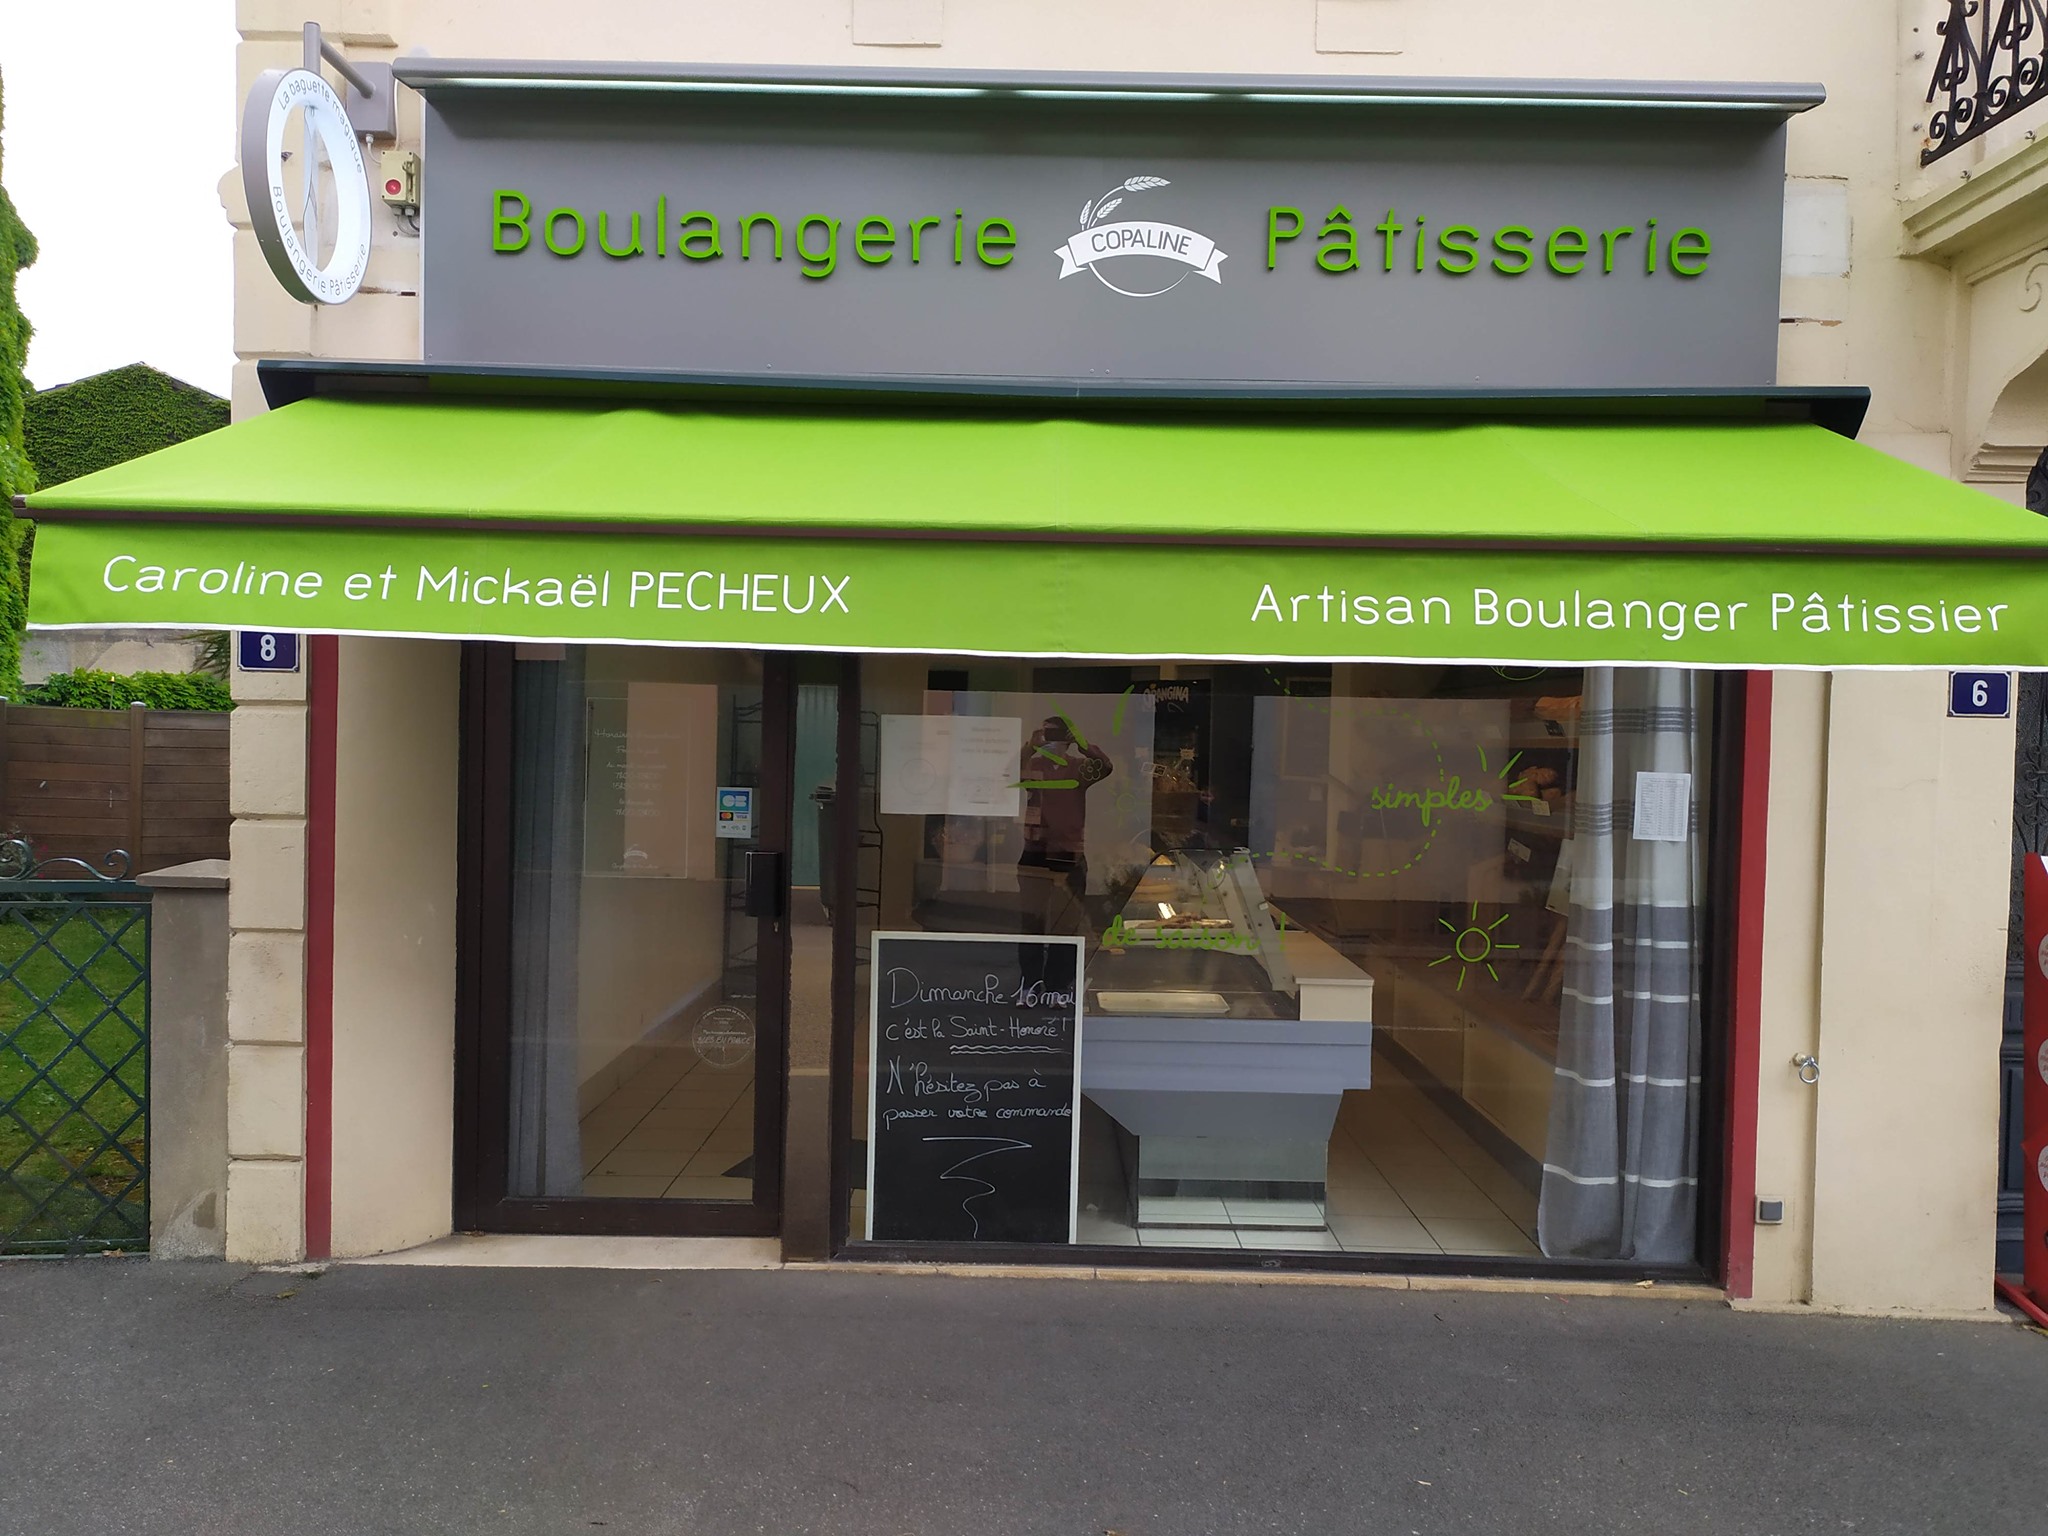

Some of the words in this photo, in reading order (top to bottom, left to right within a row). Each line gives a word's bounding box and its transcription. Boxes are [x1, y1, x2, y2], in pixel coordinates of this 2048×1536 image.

[278, 92, 291, 112] La
[289, 77, 331, 101] baguette
[331, 100, 364, 174] magique
[272, 185, 328, 295] Boulangerie
[329, 242, 367, 297] Pâtisserie
[492, 189, 1017, 279] Boulangerie
[1091, 228, 1193, 256] COPALINE
[1267, 203, 1712, 277] Pâtisserie
[102, 554, 323, 600] Caroline
[343, 563, 398, 601] et
[415, 565, 609, 609] Mickaël
[629, 569, 851, 615] PECHEUX
[1249, 583, 1452, 626] Artisan
[1473, 587, 1749, 641] Boulanger
[1770, 590, 2010, 635] Pâtissier
[260, 634, 276, 661] 8
[1972, 680, 1988, 707] 6
[1371, 775, 1493, 827] simples
[1101, 914, 1141, 947] de
[1155, 923, 1262, 950] saison
[886, 966, 1008, 1009] Dimanche
[1011, 976, 1043, 1008] 16
[1040, 986, 1076, 1008] mai
[931, 1017, 946, 1039] la
[984, 1079, 1021, 1102] pas
[1028, 1068, 1047, 1088] à
[882, 1107, 939, 1131] passer
[948, 1105, 988, 1119] votre
[995, 1102, 1073, 1120] commande
